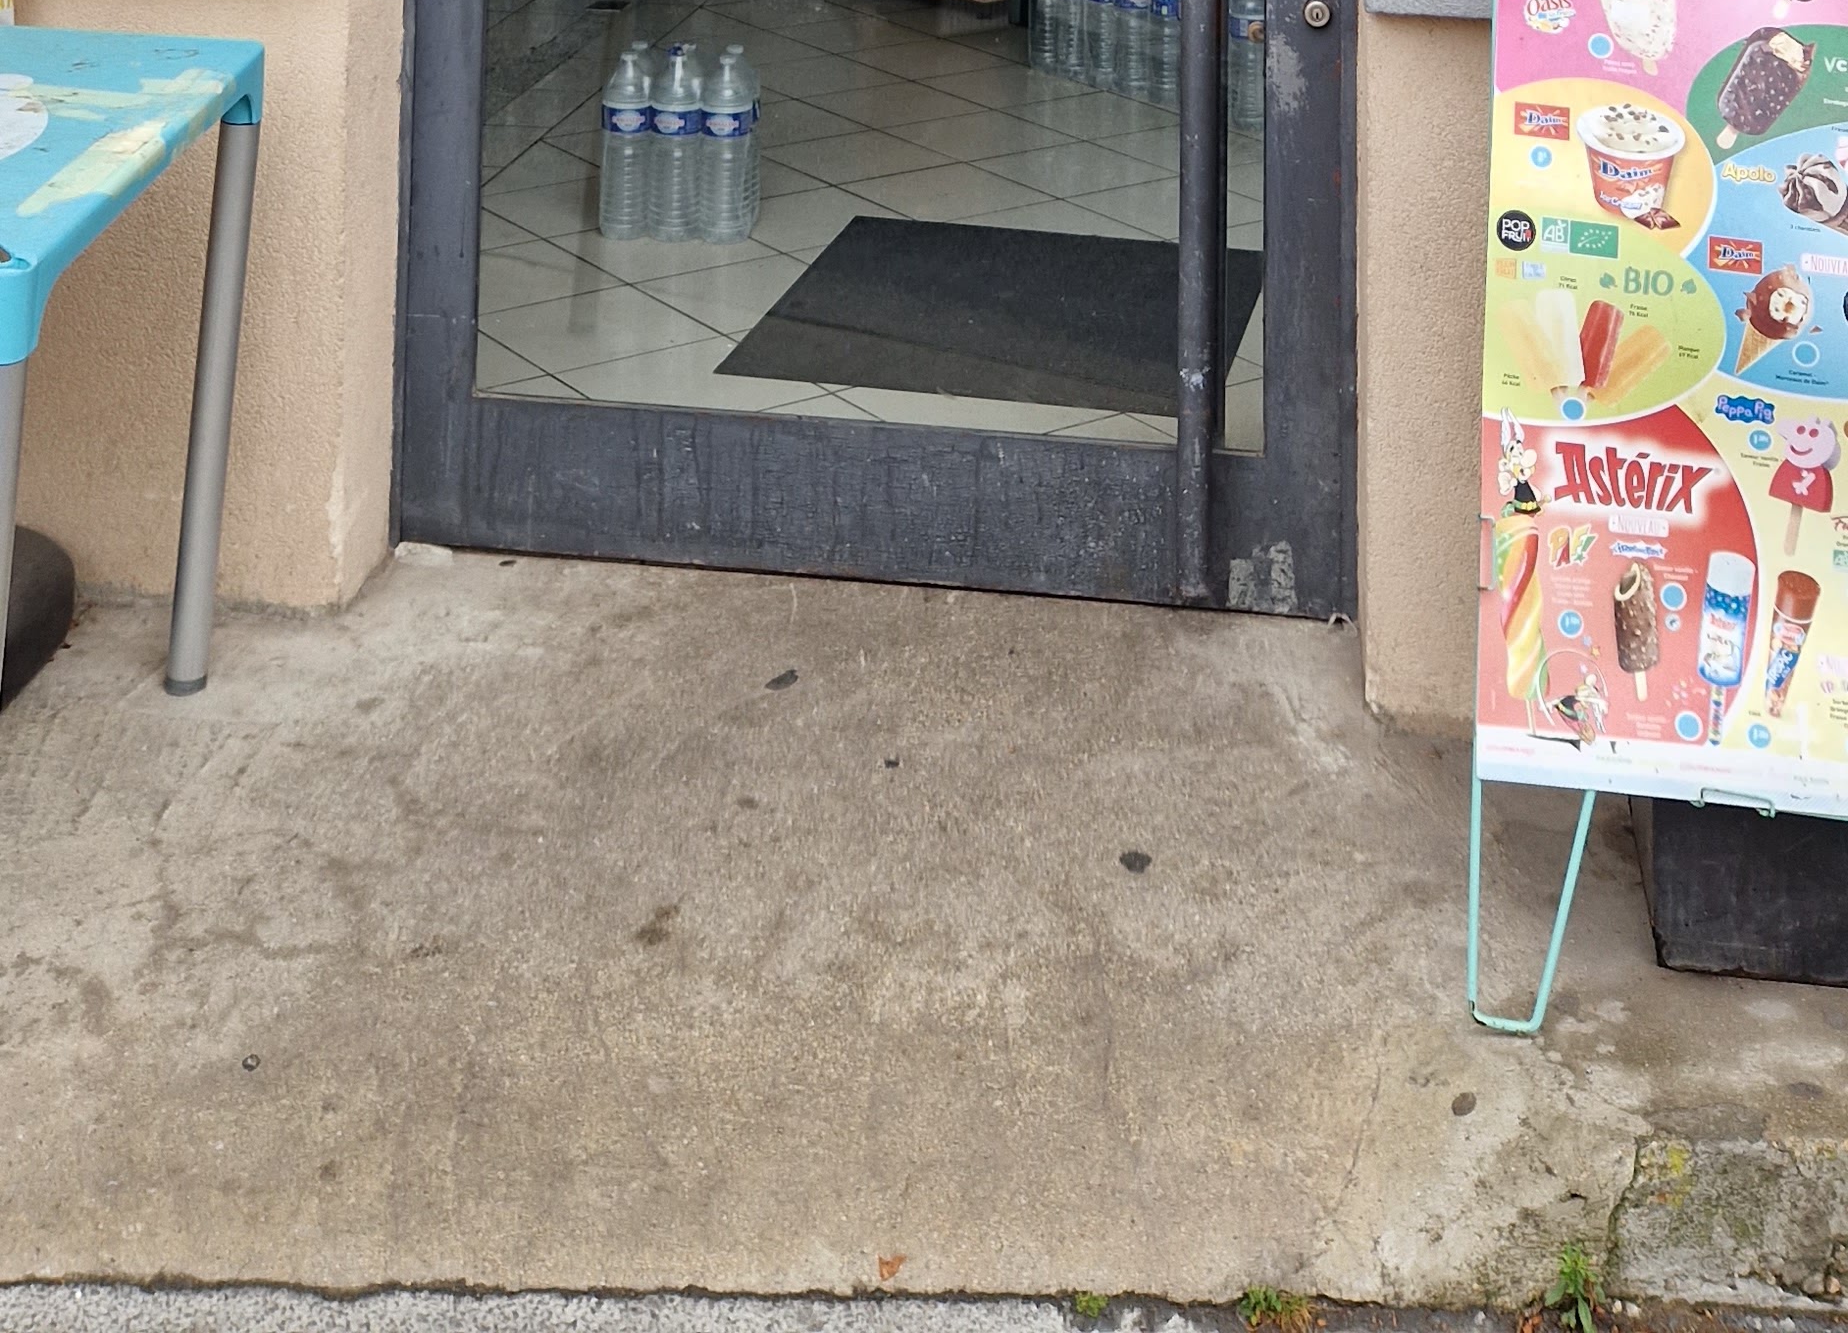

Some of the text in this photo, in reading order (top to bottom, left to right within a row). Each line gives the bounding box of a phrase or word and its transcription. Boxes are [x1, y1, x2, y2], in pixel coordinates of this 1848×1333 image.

[1526, 111, 1564, 126] Daim
[1600, 159, 1653, 179] Daim
[1722, 163, 1776, 183] Apolo
[1502, 218, 1530, 233] POP
[1543, 219, 1566, 242] AB
[1721, 245, 1754, 259] Daim
[1623, 269, 1674, 297] BIO
[1718, 395, 1773, 420] Peppa Pig
[1555, 442, 1713, 514] Astérix
